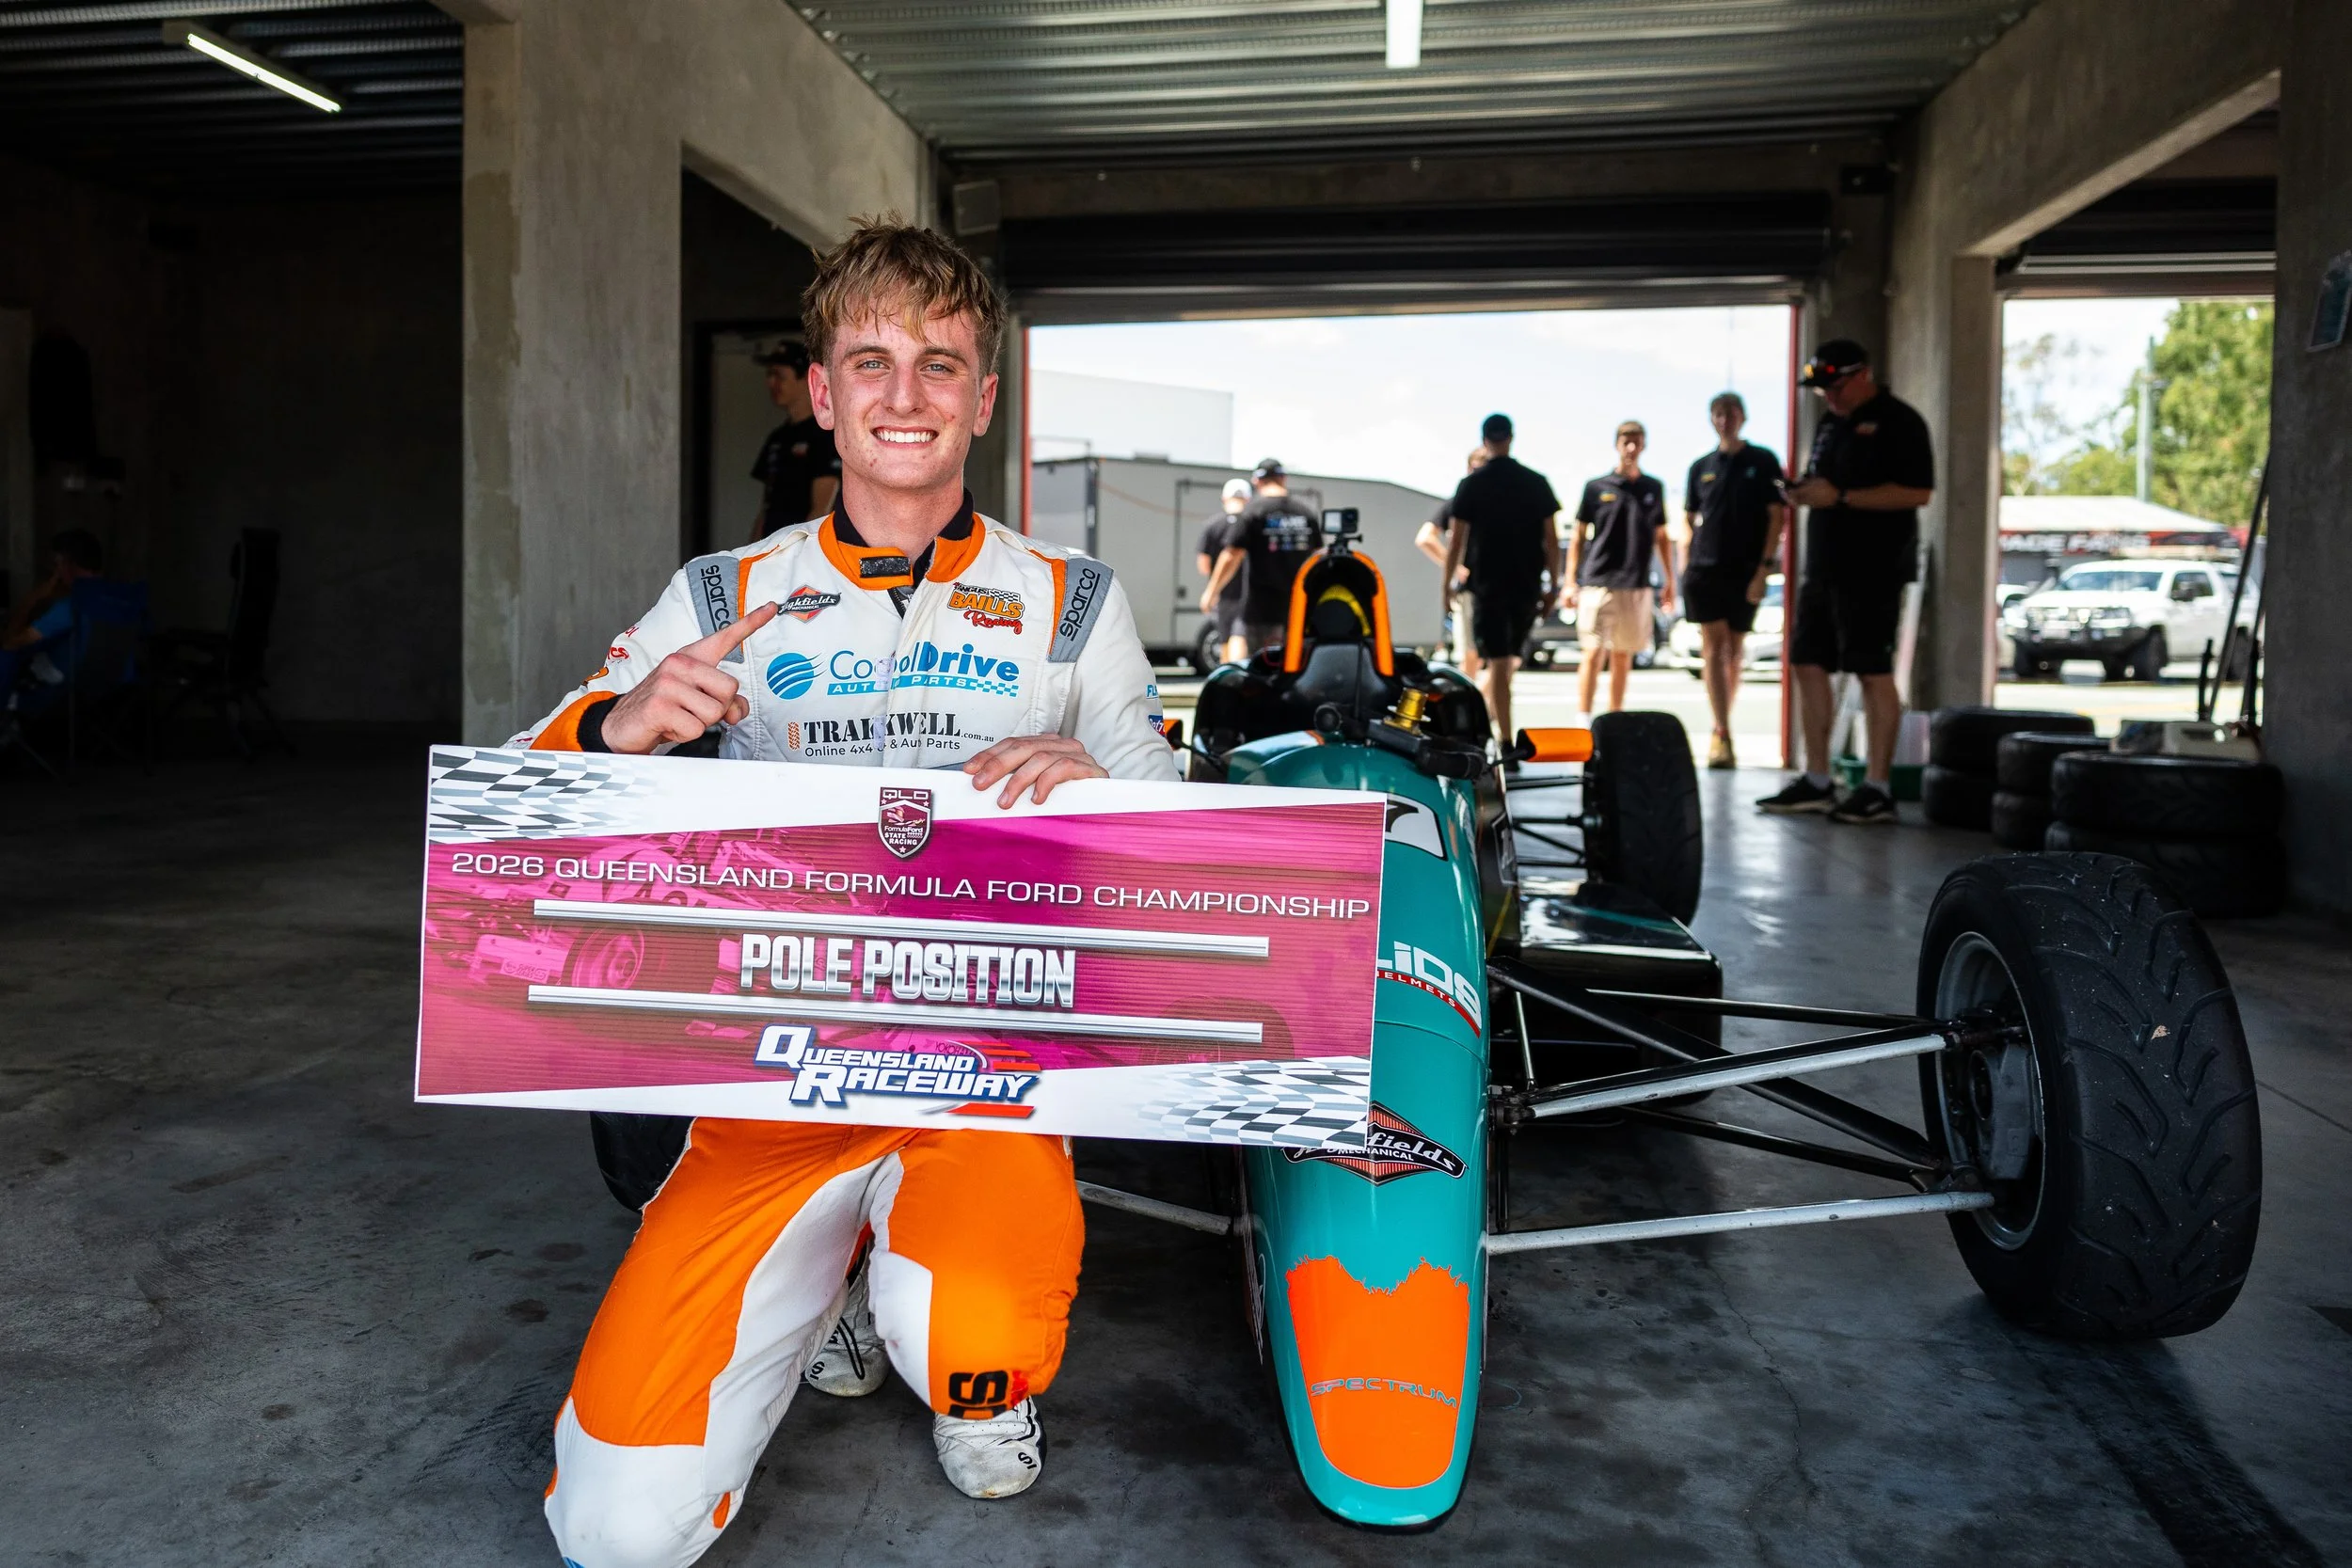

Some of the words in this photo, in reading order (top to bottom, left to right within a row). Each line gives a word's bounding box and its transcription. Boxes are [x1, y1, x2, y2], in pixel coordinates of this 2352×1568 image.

[949, 591, 1024, 619] BAILLS
[1059, 567, 1100, 641] sparco
[963, 610, 1024, 635] Racing
[804, 746, 846, 758] Online
[850, 741, 874, 754] 4x4
[927, 737, 961, 751] Parts
[882, 789, 929, 800] QLD
[452, 853, 544, 877] 2026
[555, 858, 794, 890] QUEENSLAND
[804, 871, 976, 900] FORMULA
[987, 880, 1083, 904] FORD
[1093, 886, 1370, 919] CHAMPIONSHIP
[739, 933, 853, 993] POLE
[862, 939, 1077, 1008] POSITION
[755, 1024, 976, 1072] QUEENSLAND
[789, 1064, 1034, 1104] RACEWAY
[1338, 1147, 1414, 1162] MECHANICAL
